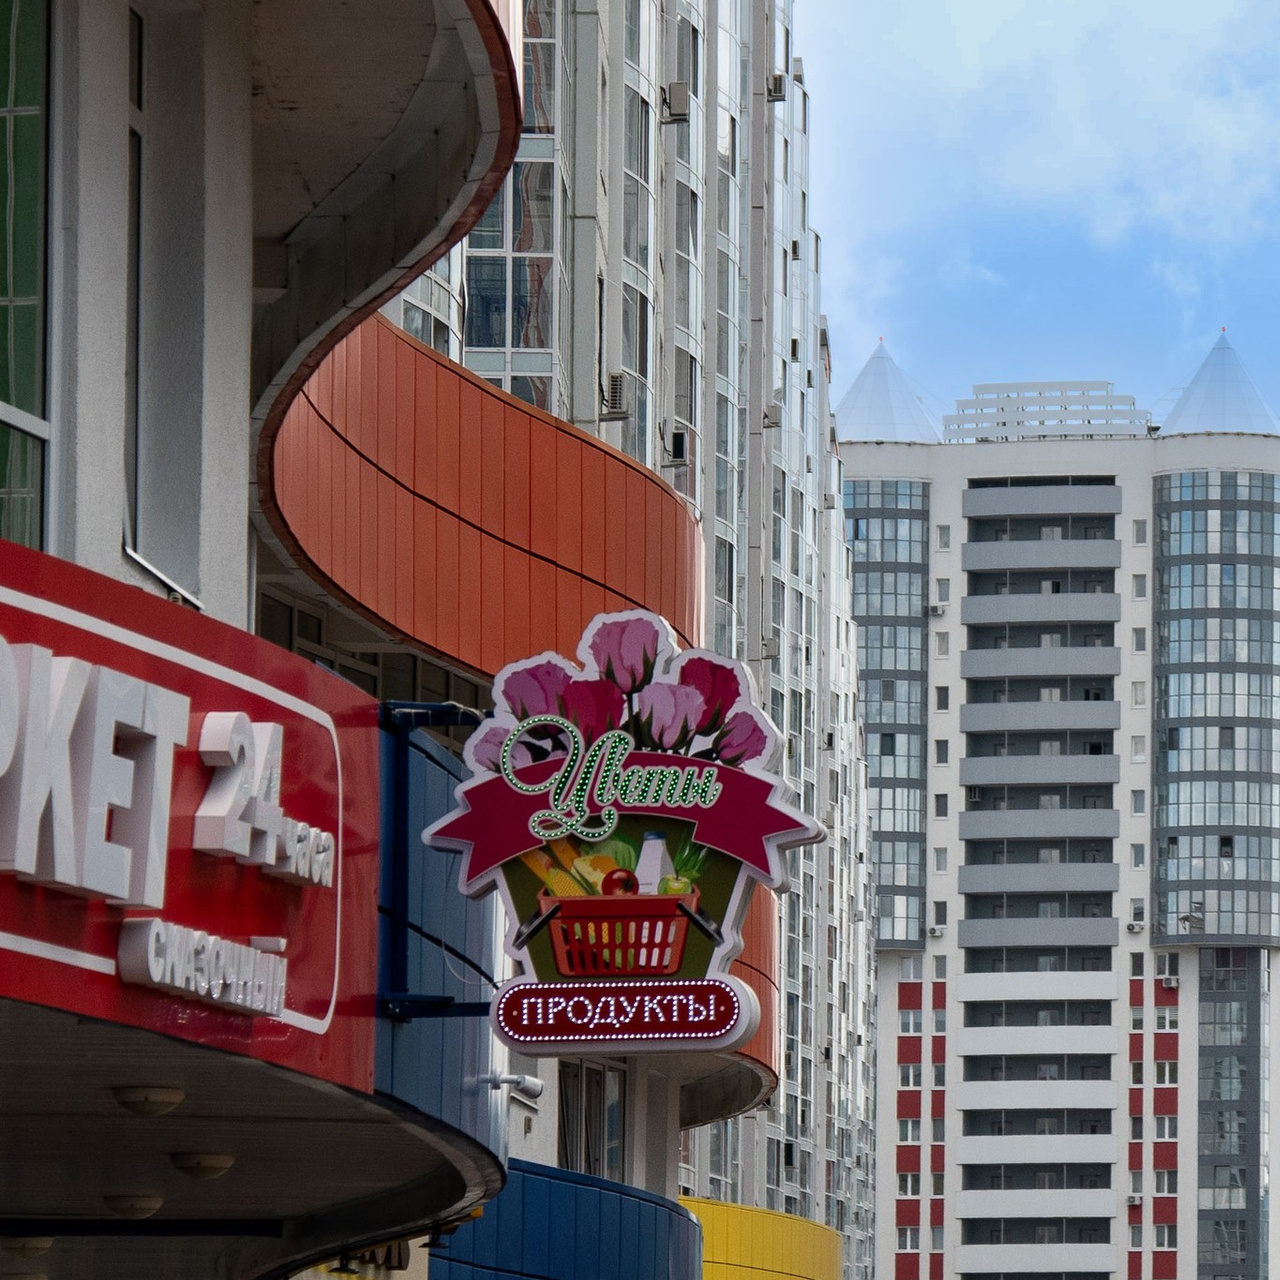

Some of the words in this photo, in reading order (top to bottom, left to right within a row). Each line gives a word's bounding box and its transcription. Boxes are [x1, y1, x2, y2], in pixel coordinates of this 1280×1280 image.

[193, 711, 284, 866] 24
[270, 817, 335, 888] часа
[500, 715, 723, 840] Цветы
[118, 917, 288, 1018] СКАЗОЧНЫЙ
[520, 993, 717, 1028] ПРОДУКТЫ
